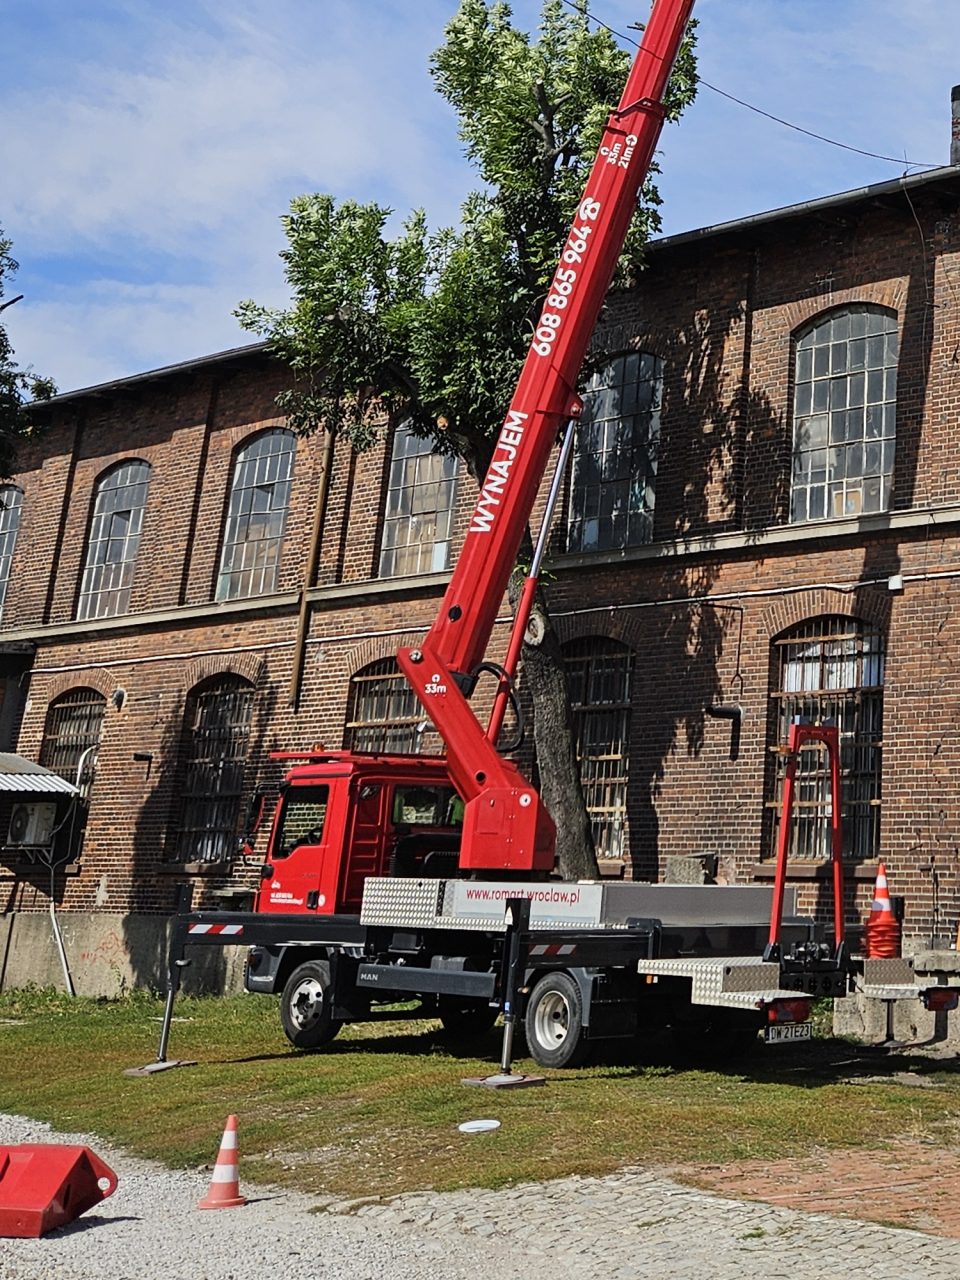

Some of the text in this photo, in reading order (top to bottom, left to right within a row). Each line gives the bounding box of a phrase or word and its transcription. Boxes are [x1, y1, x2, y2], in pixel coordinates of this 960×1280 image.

[607, 143, 622, 165] 33m
[618, 147, 635, 169] 21m
[532, 226, 592, 356] 608 865 964
[470, 410, 529, 532] WYNAJEM
[425, 683, 447, 694] 33m
[466, 888, 580, 906] www.romartwroclaw.pl
[360, 973, 378, 981] MAN
[784, 1024, 810, 1039] 2TE23
